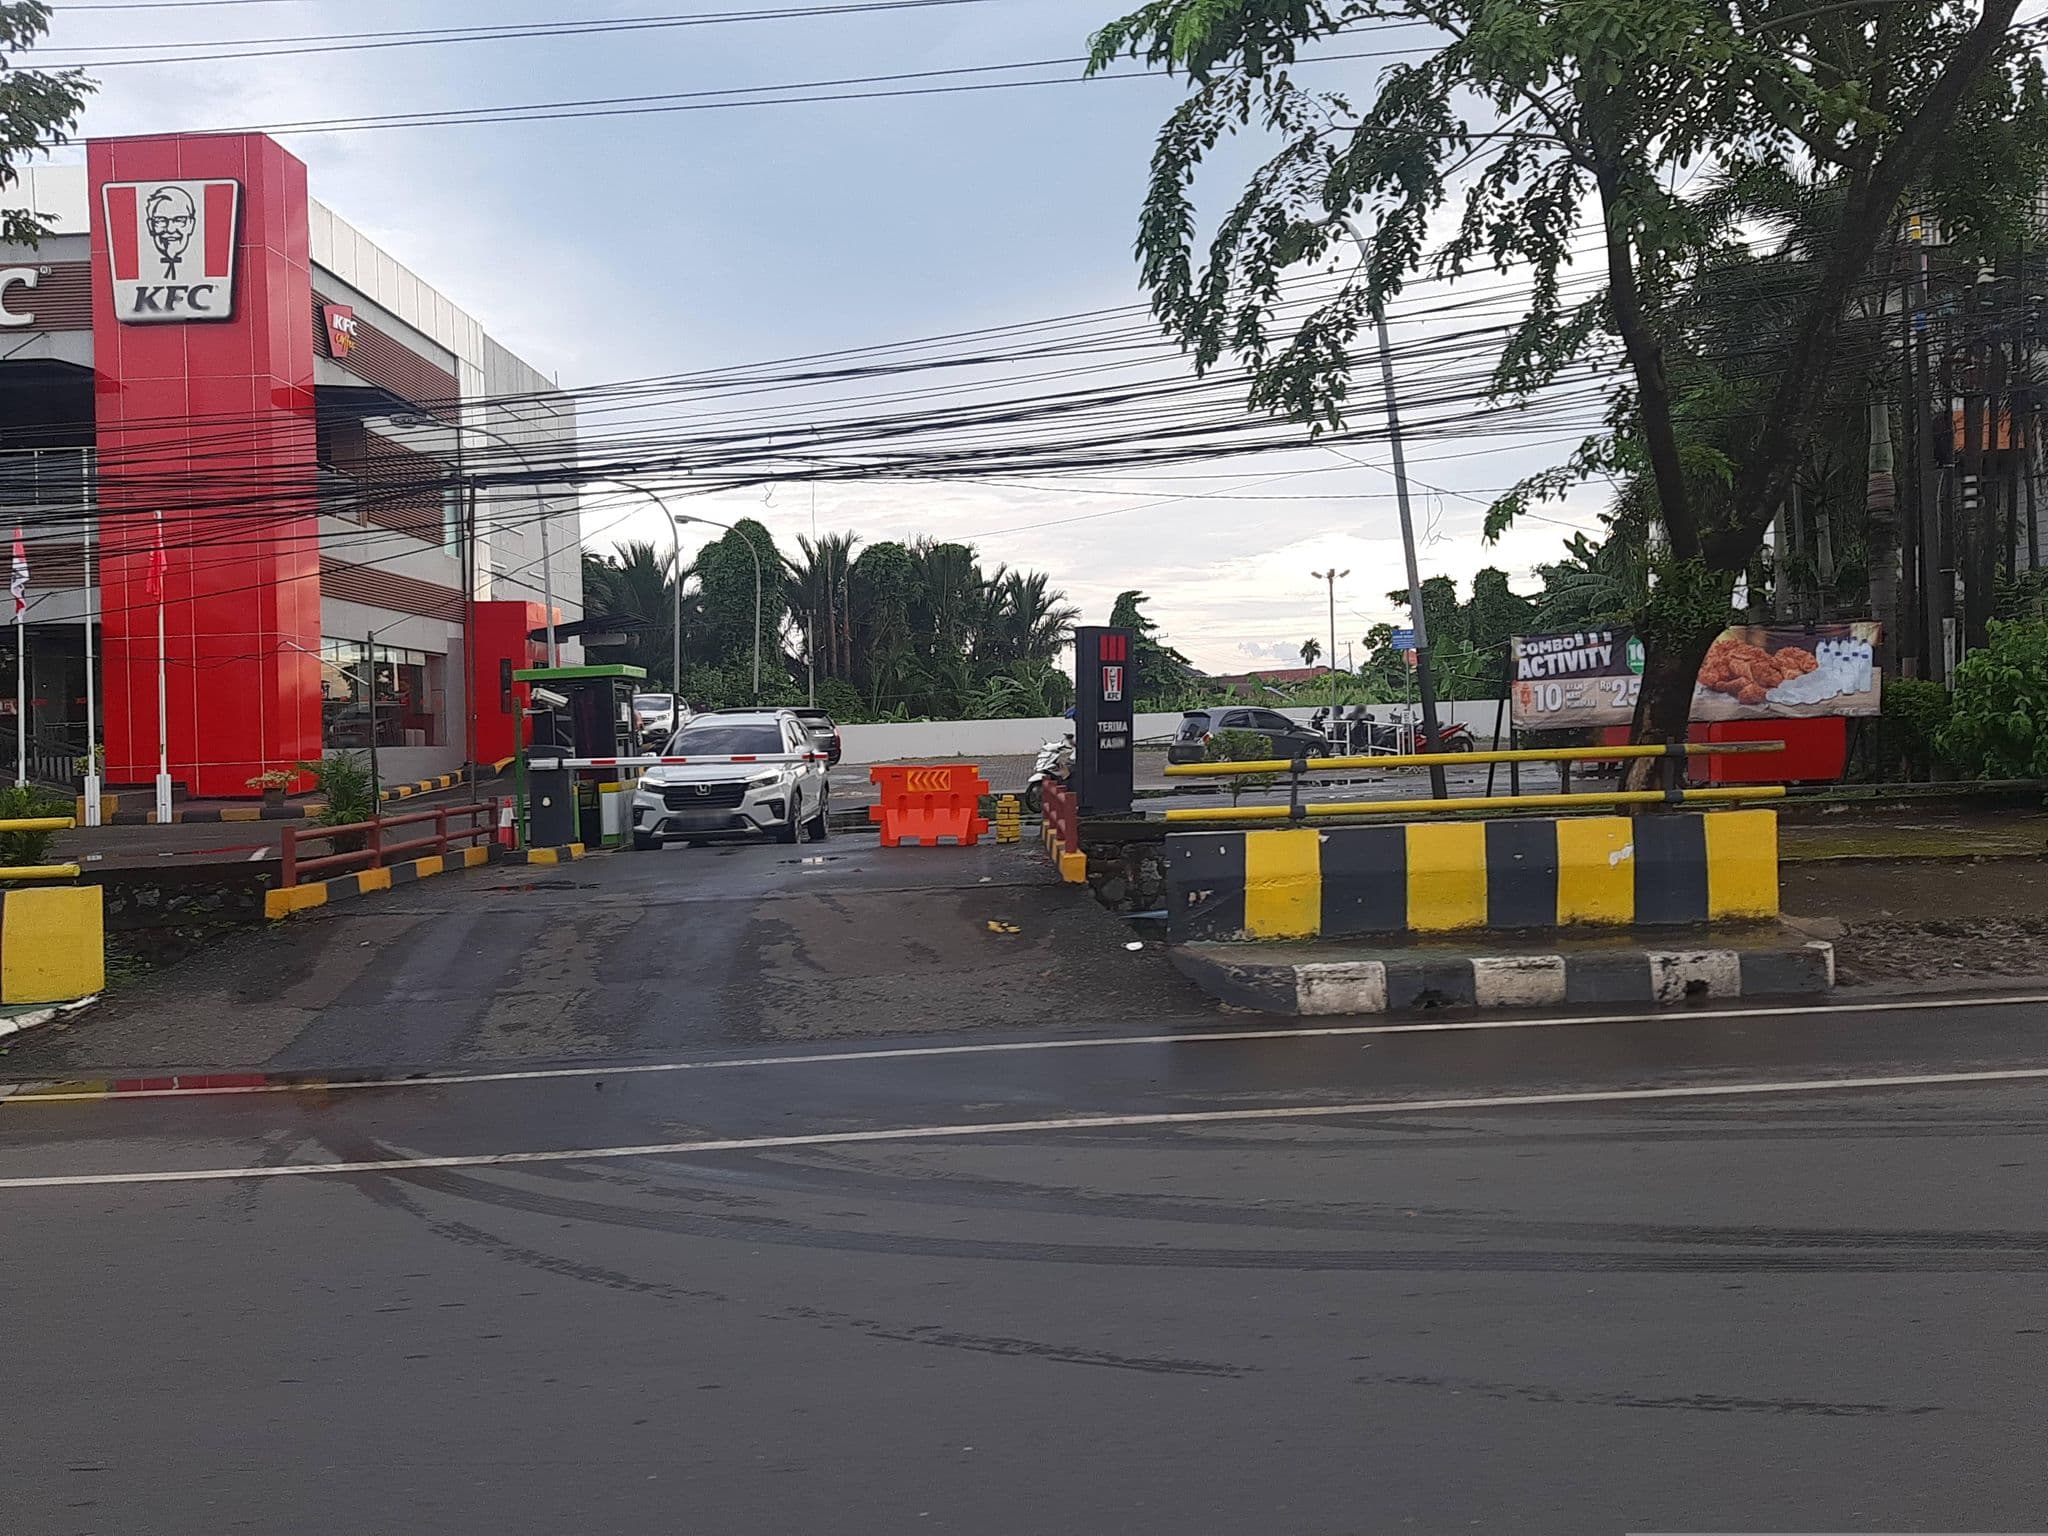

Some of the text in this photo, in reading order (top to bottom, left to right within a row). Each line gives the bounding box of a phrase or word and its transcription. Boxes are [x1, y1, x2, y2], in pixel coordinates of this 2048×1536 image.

[133, 284, 214, 312] KFC
[333, 314, 357, 336] KFC
[1516, 637, 1575, 657] COMBO
[1518, 645, 1613, 680] ACTIVITY
[1107, 692, 1120, 700] KFC
[1534, 683, 1562, 713] 10
[1097, 721, 1129, 733] TERIMA
